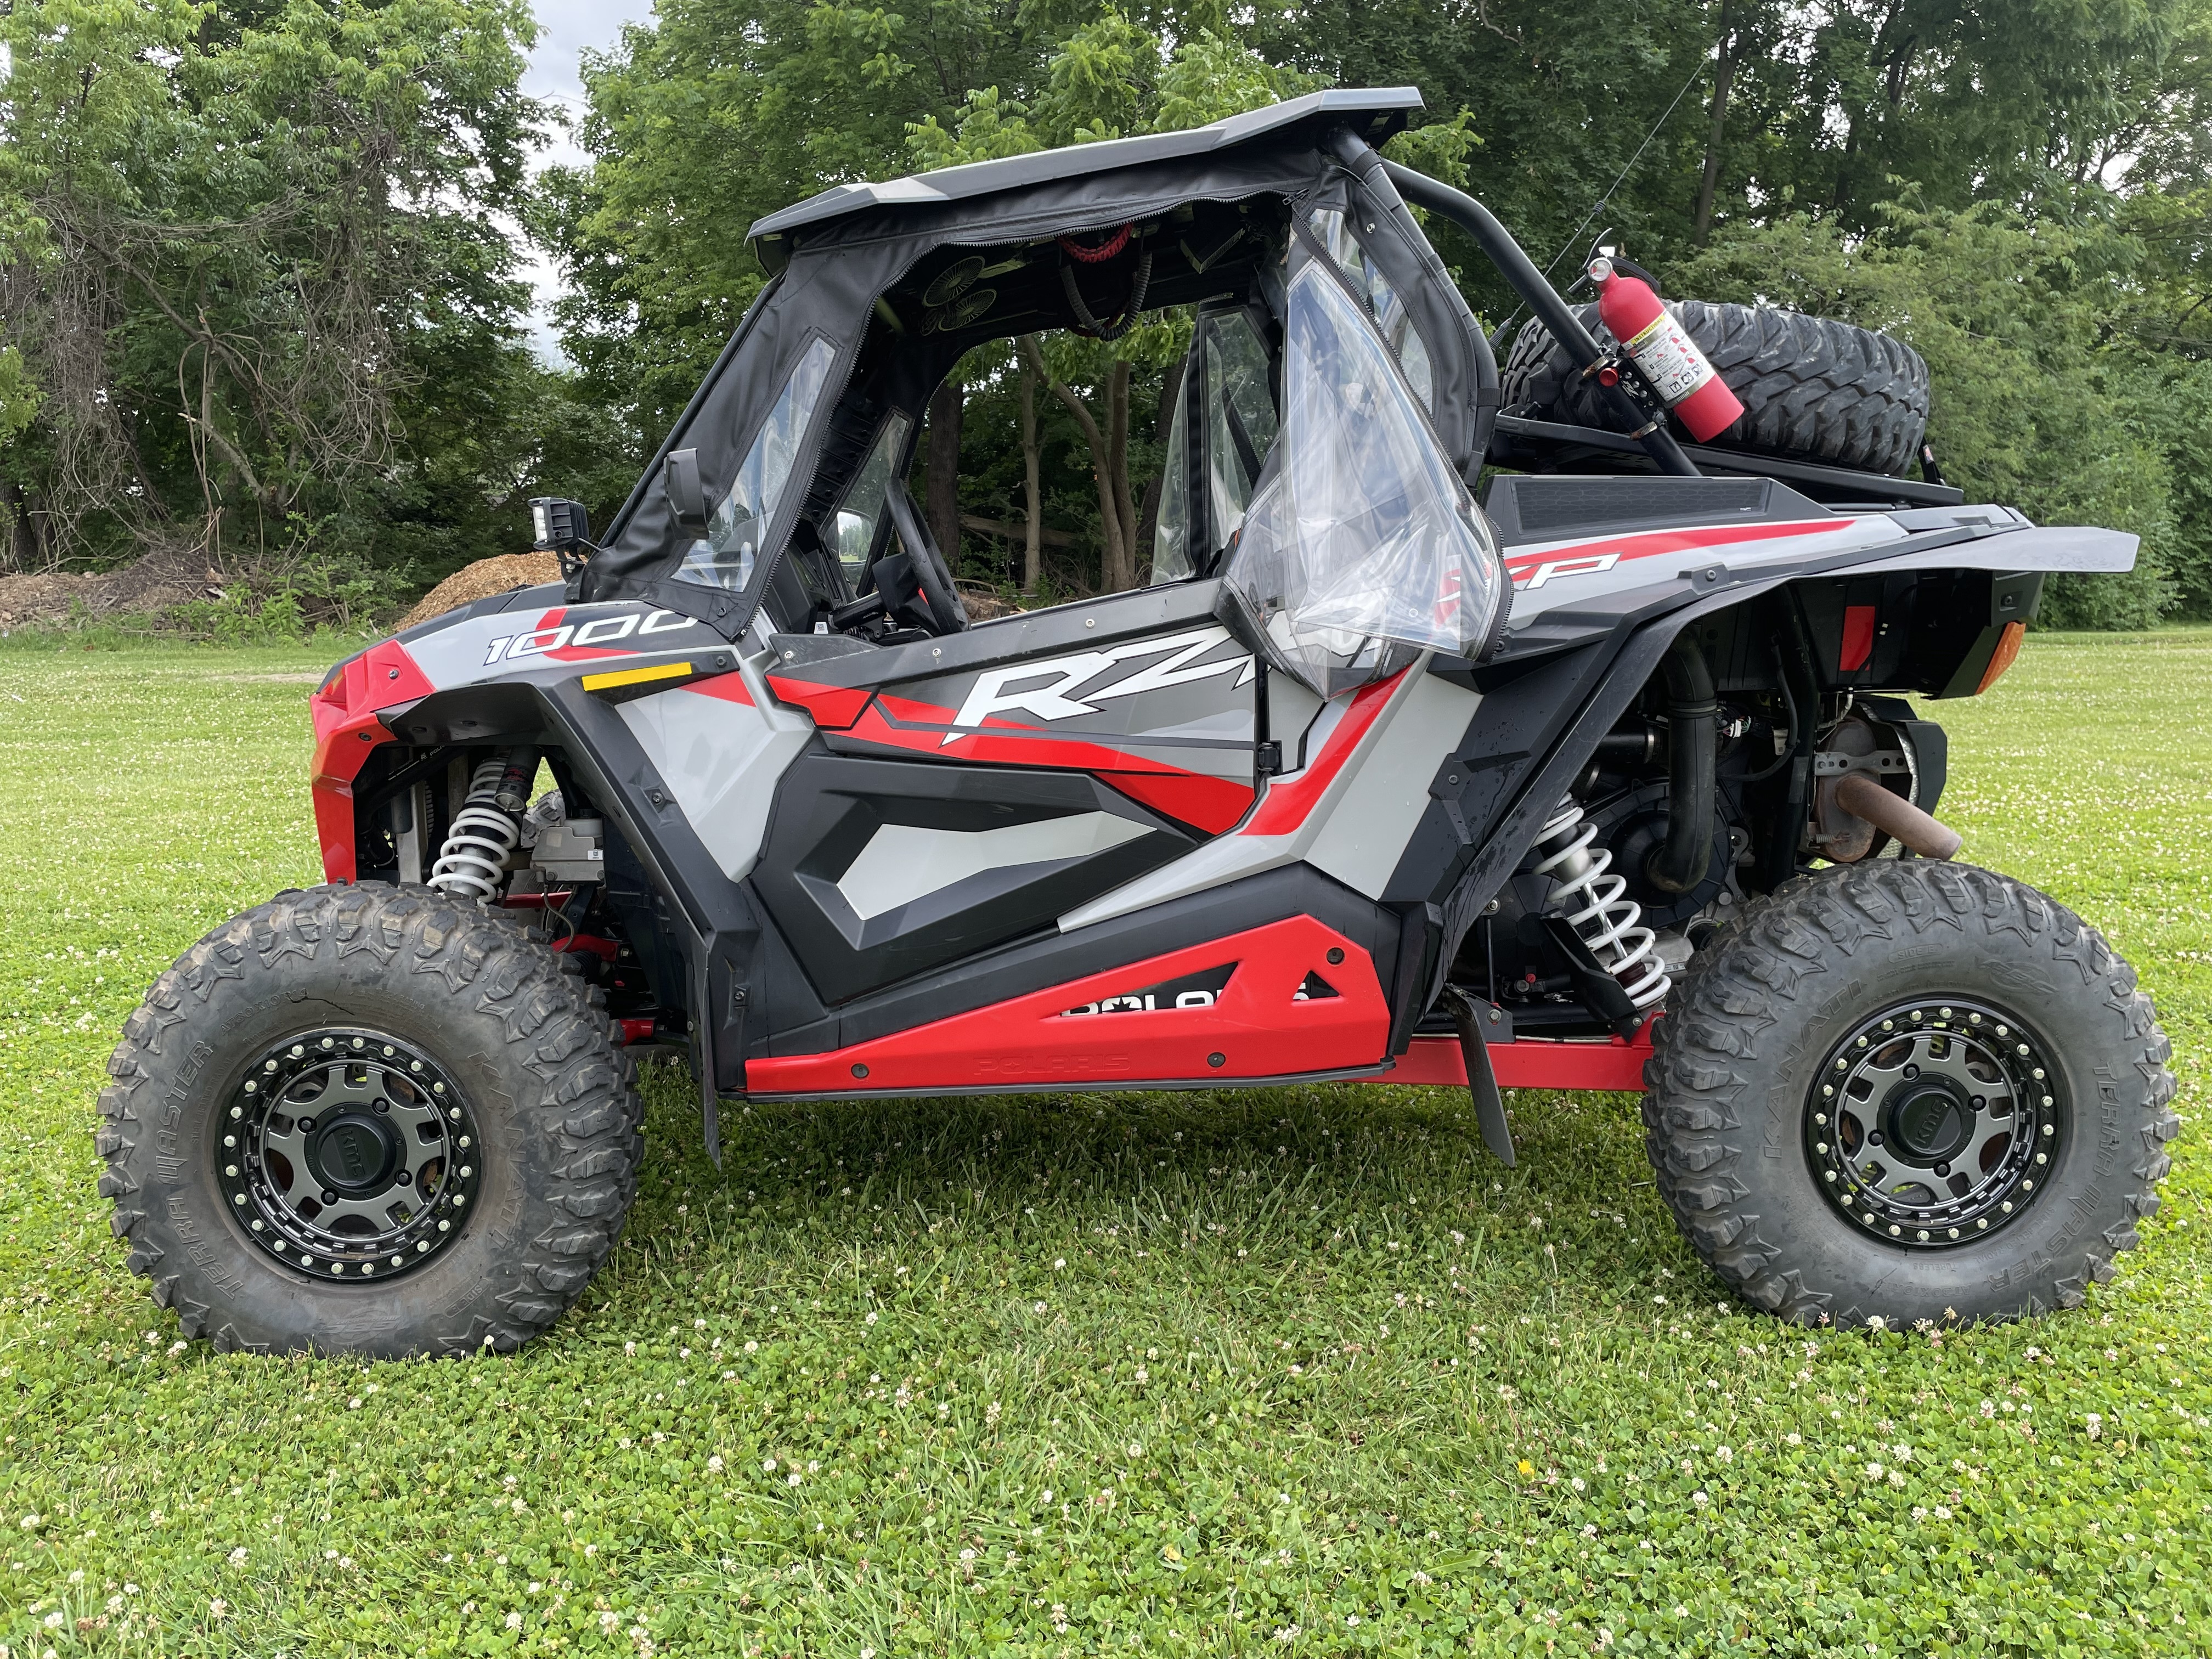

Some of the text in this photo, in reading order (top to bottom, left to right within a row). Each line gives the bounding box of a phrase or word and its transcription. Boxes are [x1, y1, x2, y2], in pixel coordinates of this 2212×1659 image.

[1634, 318, 1662, 342] INSTRUCTIONS
[483, 608, 698, 667] 1000
[973, 1053, 1131, 1076] POLARIS
[1764, 978, 1864, 1158] KANATI
[466, 1049, 527, 1250] KANATI
[2091, 1061, 2121, 1178] TERRA
[163, 1194, 245, 1300] TERRA
[459, 1282, 485, 1306] SIDE
